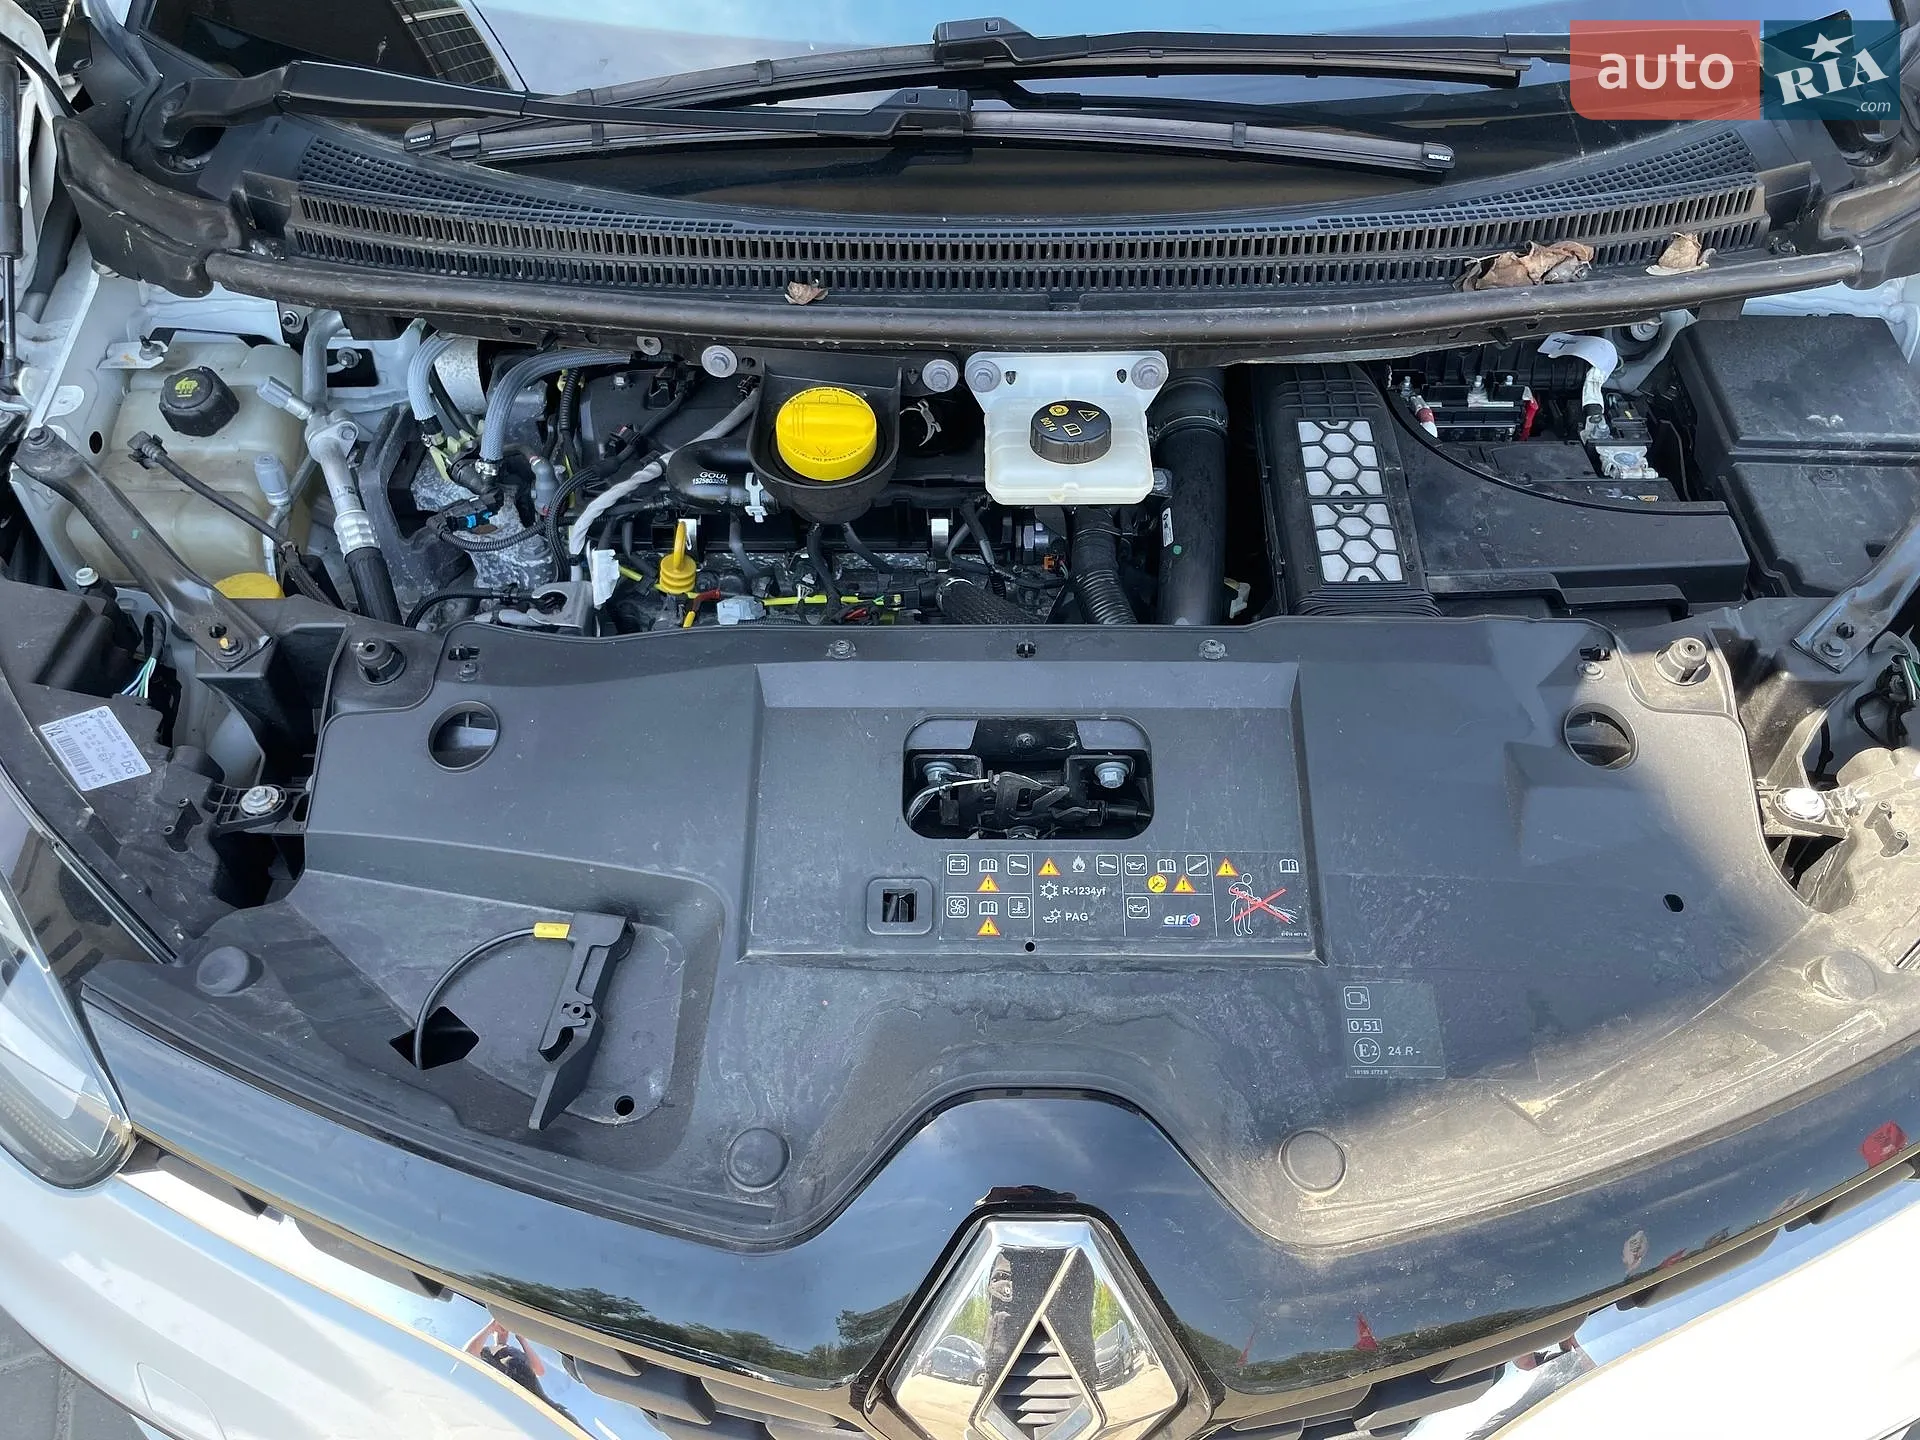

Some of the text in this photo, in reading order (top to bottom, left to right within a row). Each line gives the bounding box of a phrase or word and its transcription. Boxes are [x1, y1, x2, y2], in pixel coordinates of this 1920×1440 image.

[1062, 886, 1107, 896] R-1234yf
[1065, 912, 1089, 922] PAG
[1164, 914, 1187, 925] elf
[1350, 1020, 1380, 1033] 0,51
[1388, 1046, 1402, 1056] 24
